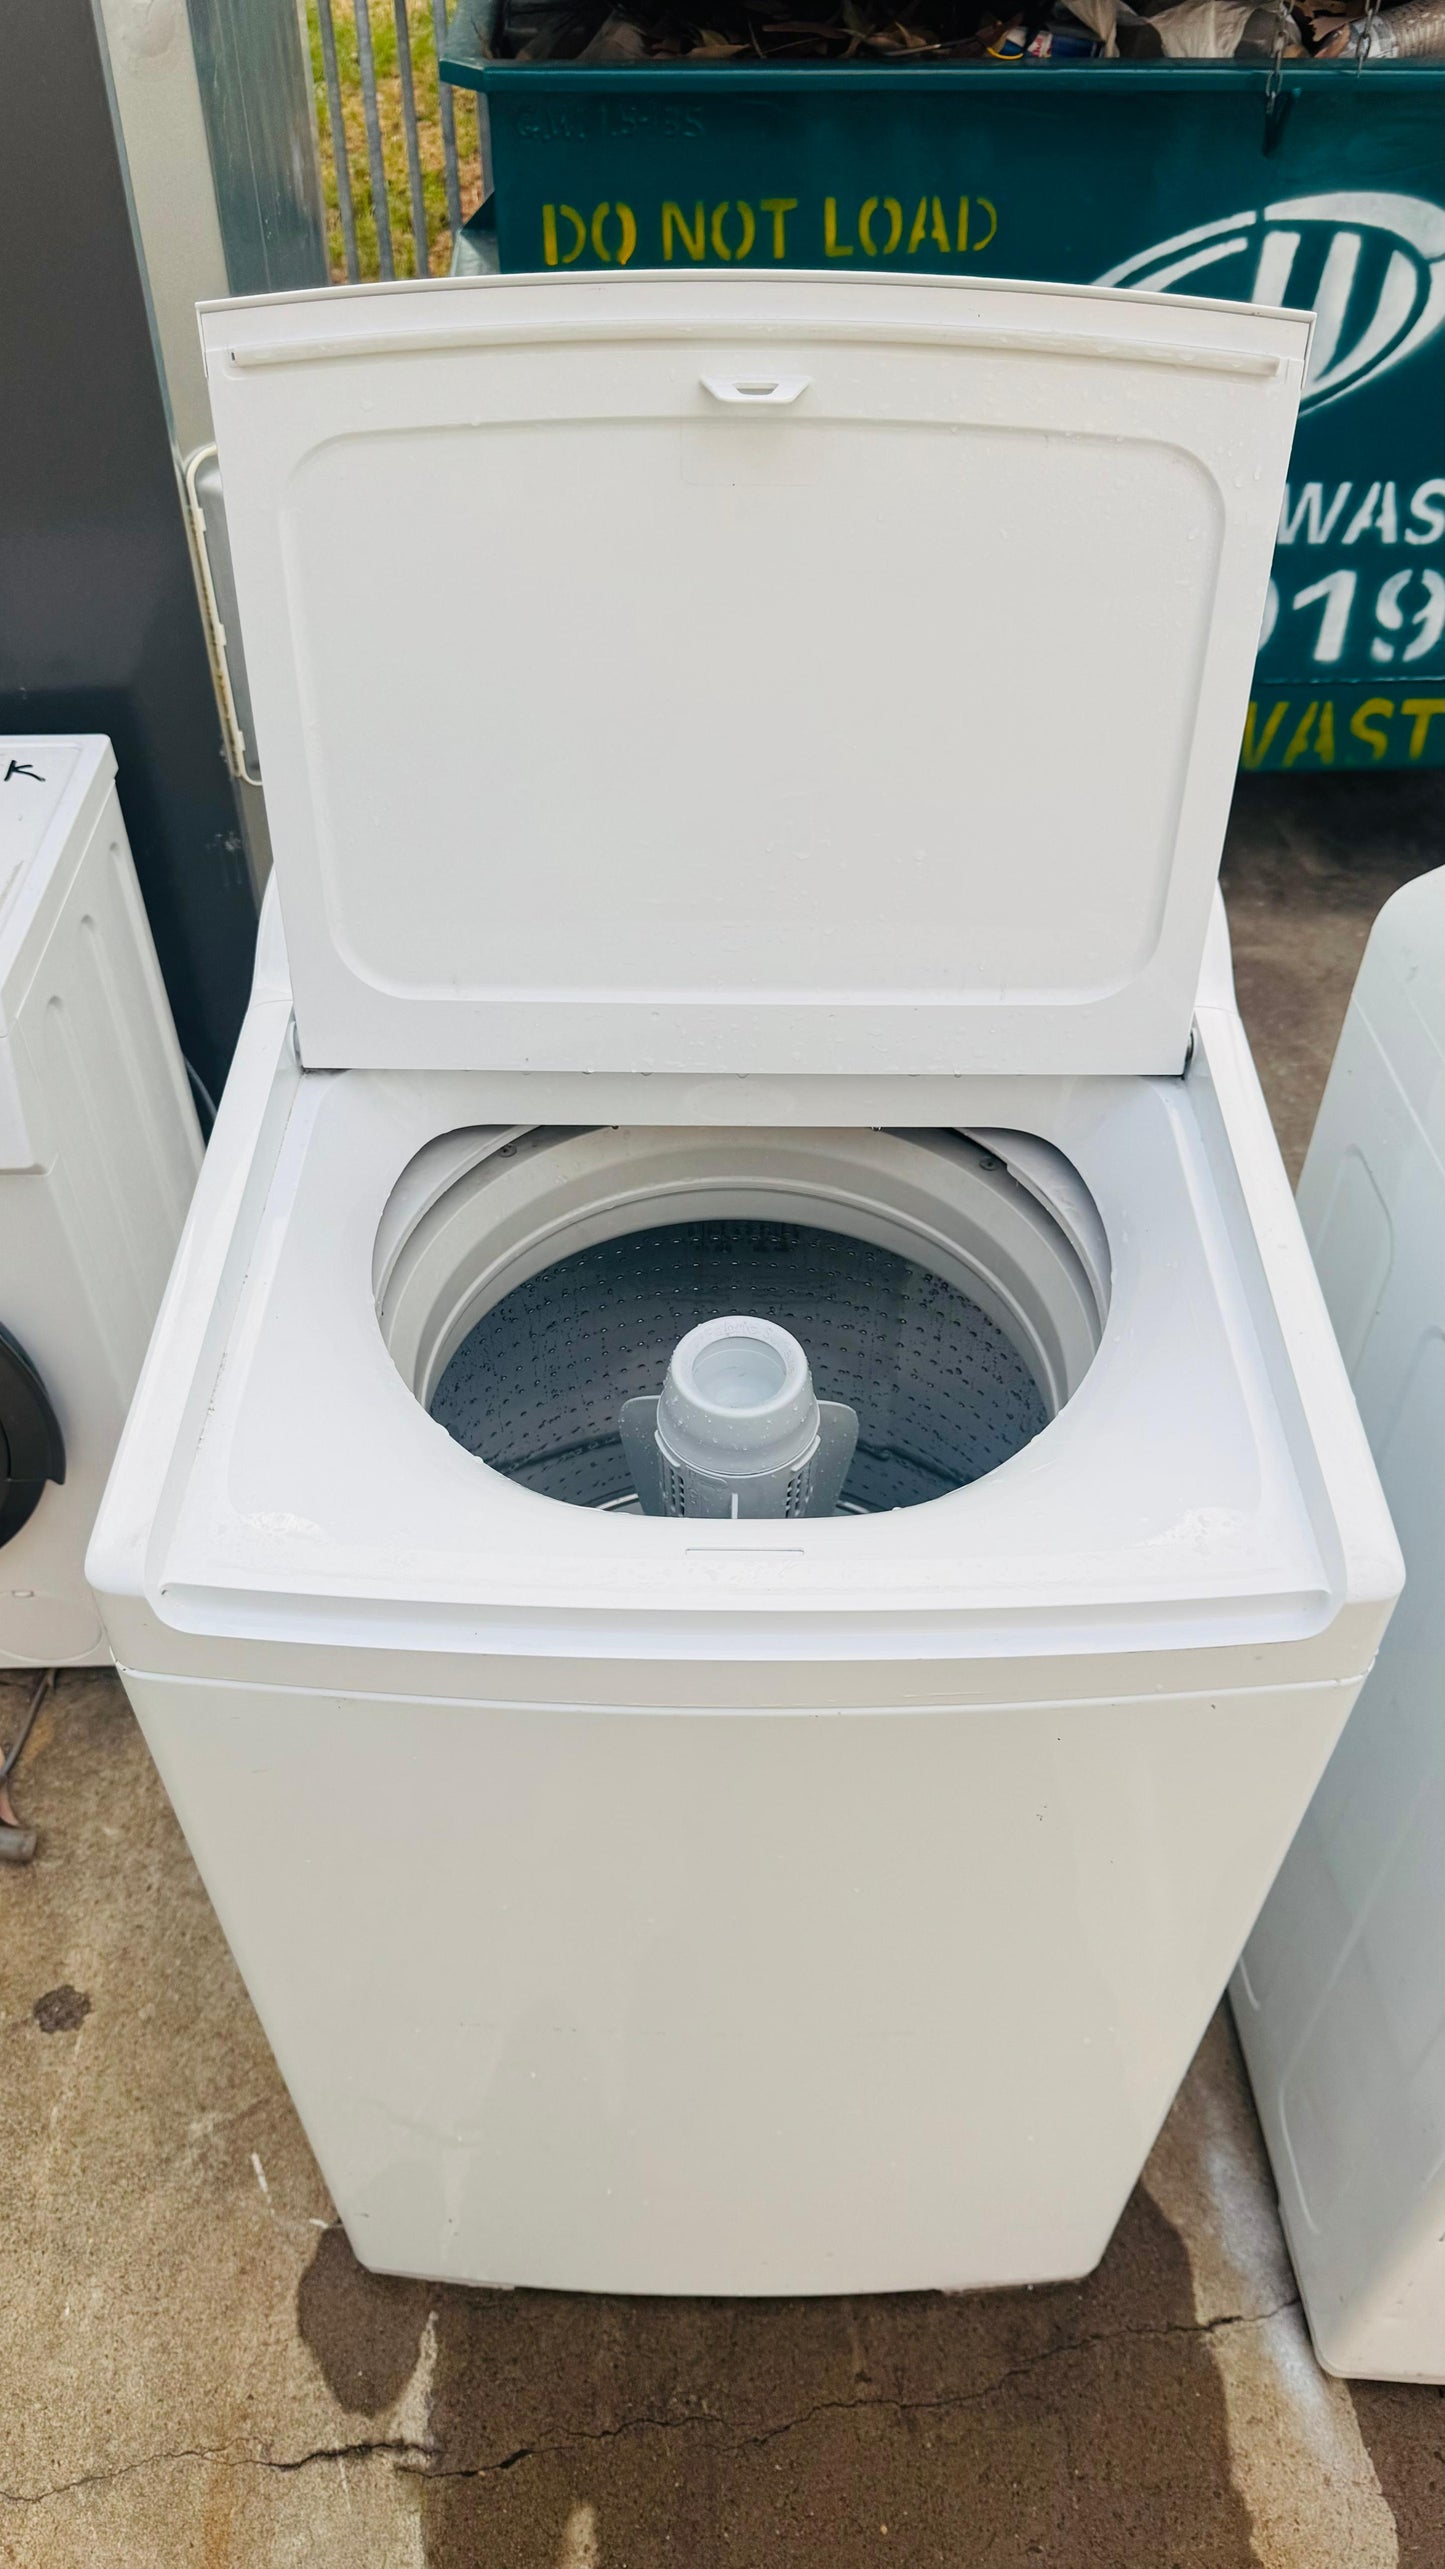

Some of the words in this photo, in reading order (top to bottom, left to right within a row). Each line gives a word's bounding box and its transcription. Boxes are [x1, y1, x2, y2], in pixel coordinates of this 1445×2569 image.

[542, 202, 637, 265] DO
[662, 199, 797, 261] NOT
[824, 196, 997, 258] LOAD
[1277, 479, 1445, 545] WAS
